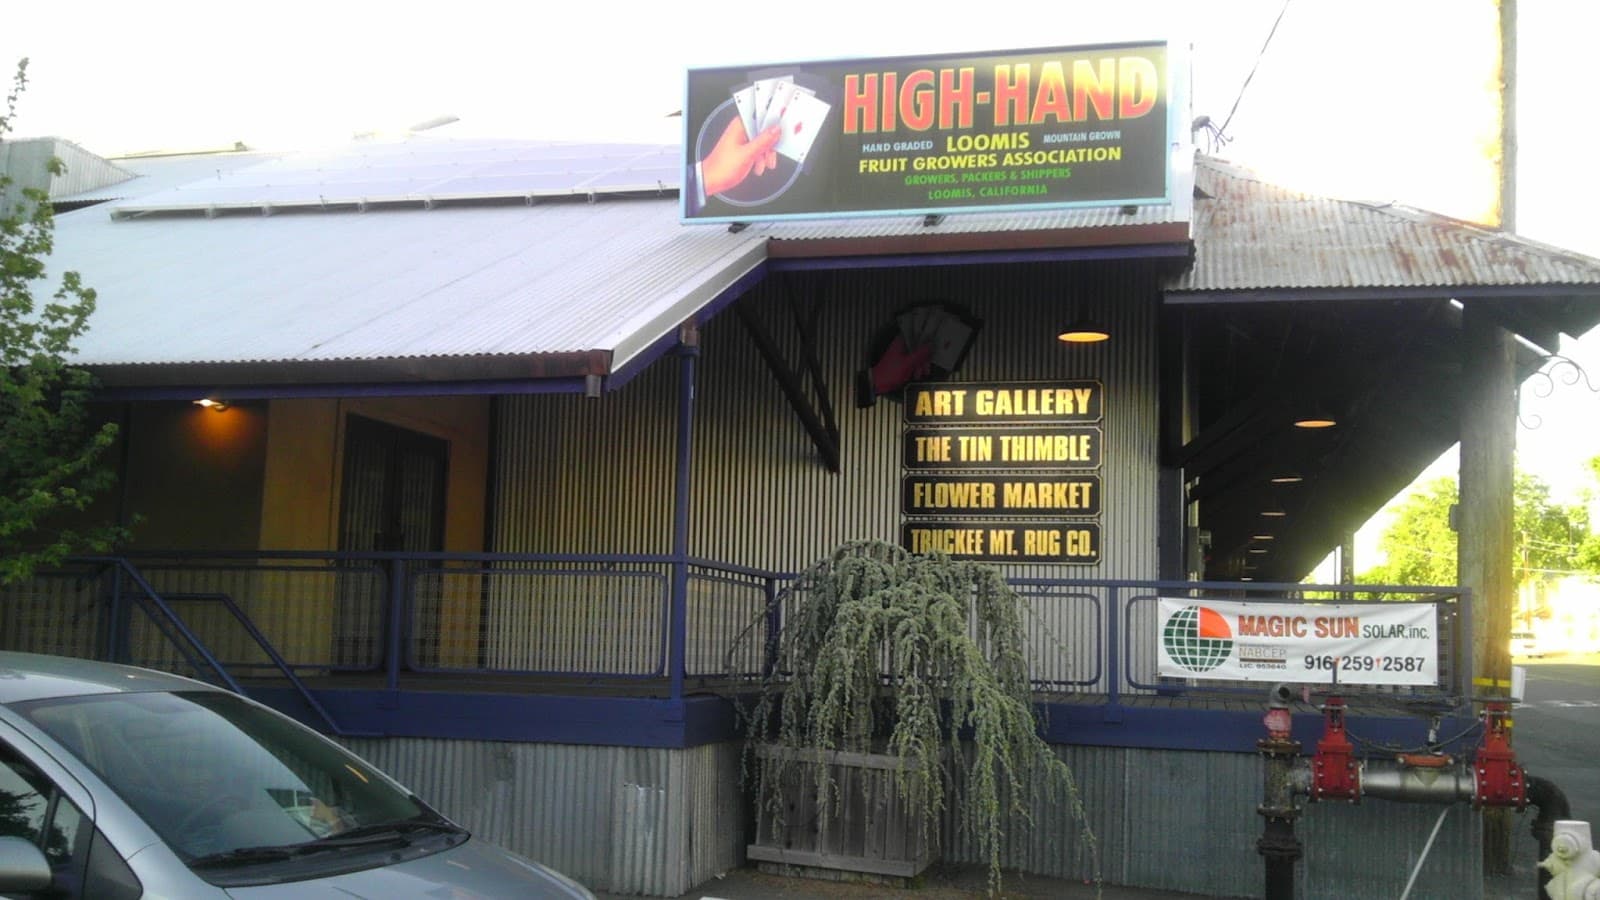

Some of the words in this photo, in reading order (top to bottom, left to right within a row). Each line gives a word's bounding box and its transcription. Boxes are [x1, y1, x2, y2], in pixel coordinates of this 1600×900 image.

[843, 57, 1158, 134] HIGH-HAND
[862, 143, 891, 153] HAND
[893, 140, 934, 152] GRADED
[946, 132, 1030, 153] LOOMIS
[1043, 132, 1087, 144] MOUNTAIN
[1088, 130, 1121, 141] GROWN
[859, 157, 909, 173] FRUIT
[913, 153, 997, 171] GROWERS
[1002, 146, 1122, 167] ASSOCIATION
[962, 170, 1007, 183] PACKERS
[1010, 171, 1018, 181] &
[1021, 167, 1072, 180] SHIPPERS
[979, 184, 1048, 198] CALIFORNIA
[915, 390, 967, 416] ART
[975, 388, 1092, 416] GALLERY
[915, 436, 951, 462] THE
[958, 436, 992, 462] TIN
[1000, 435, 1091, 462] THIMBLE
[913, 482, 995, 508] FLOWER
[1003, 482, 1092, 508] MARKET
[911, 529, 984, 555] TRUCKEE
[990, 529, 1018, 555] MT.
[1024, 529, 1060, 556] RUG
[1066, 529, 1097, 556] CO.
[1238, 615, 1307, 638] MAGIC
[1314, 616, 1360, 639] SUN
[1239, 647, 1287, 658] NABCEP
